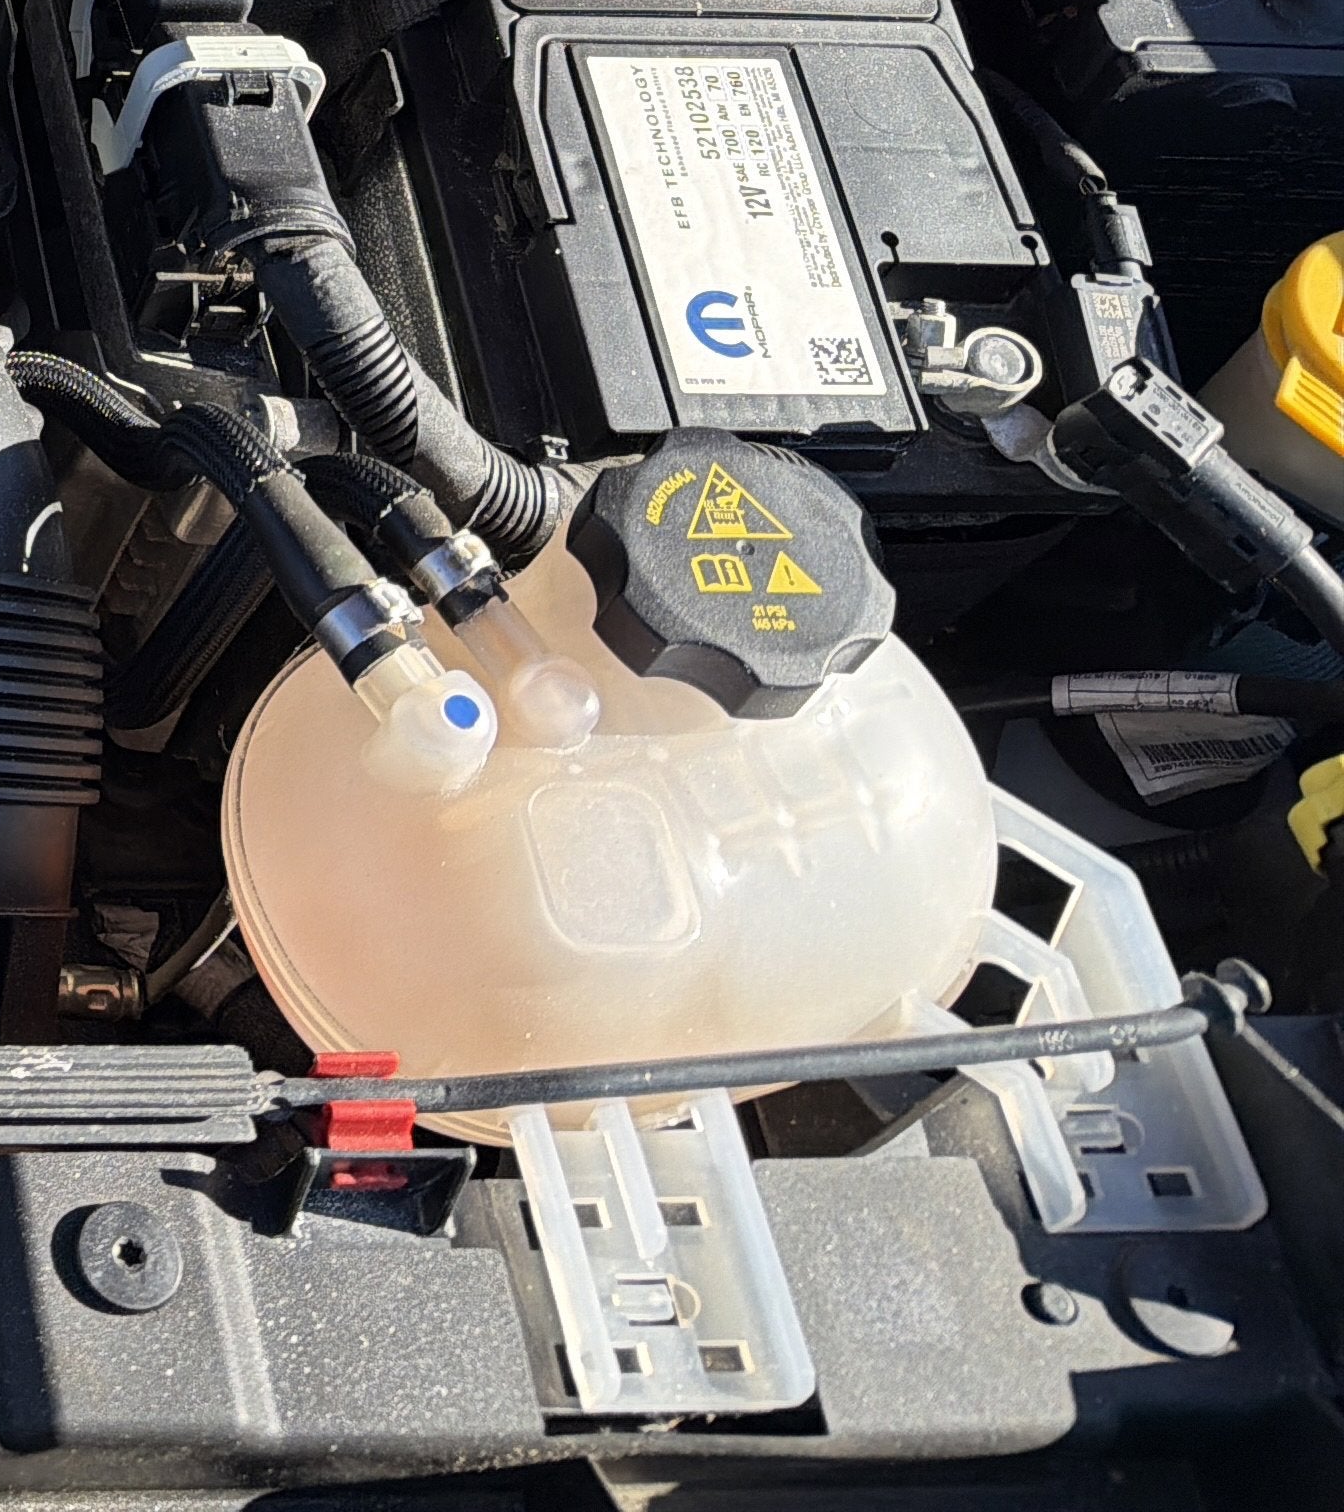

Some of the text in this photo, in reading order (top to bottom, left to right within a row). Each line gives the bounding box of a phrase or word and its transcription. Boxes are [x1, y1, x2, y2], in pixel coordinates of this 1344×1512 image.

[630, 65, 691, 229] EFB TECHNOLOGY
[674, 66, 721, 160] 52102538
[704, 75, 749, 182] SAE 700 Ahr 70
[726, 71, 771, 177] RC 120 EN 760
[738, 184, 774, 219] 12V
[743, 291, 771, 359] MOPAR
